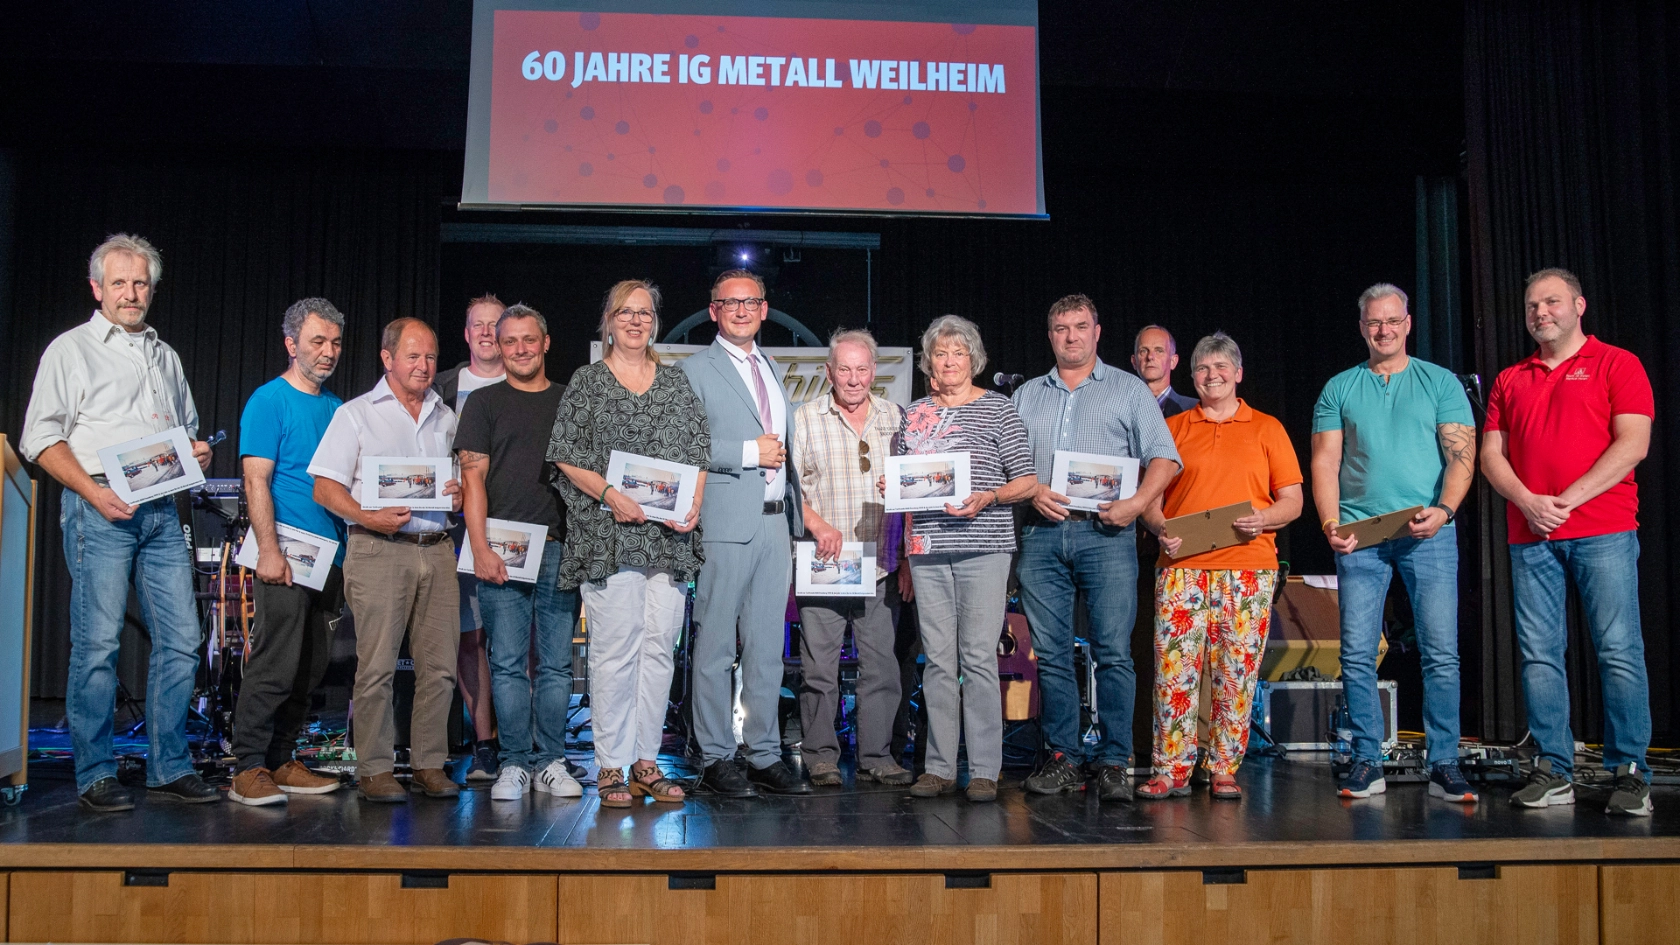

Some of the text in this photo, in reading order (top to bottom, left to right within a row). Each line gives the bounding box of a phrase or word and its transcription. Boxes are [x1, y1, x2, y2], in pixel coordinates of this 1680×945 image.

[521, 50, 1006, 93] 60 JAHRE IG METALL WEILHEIM
[183, 524, 193, 550] PRO
